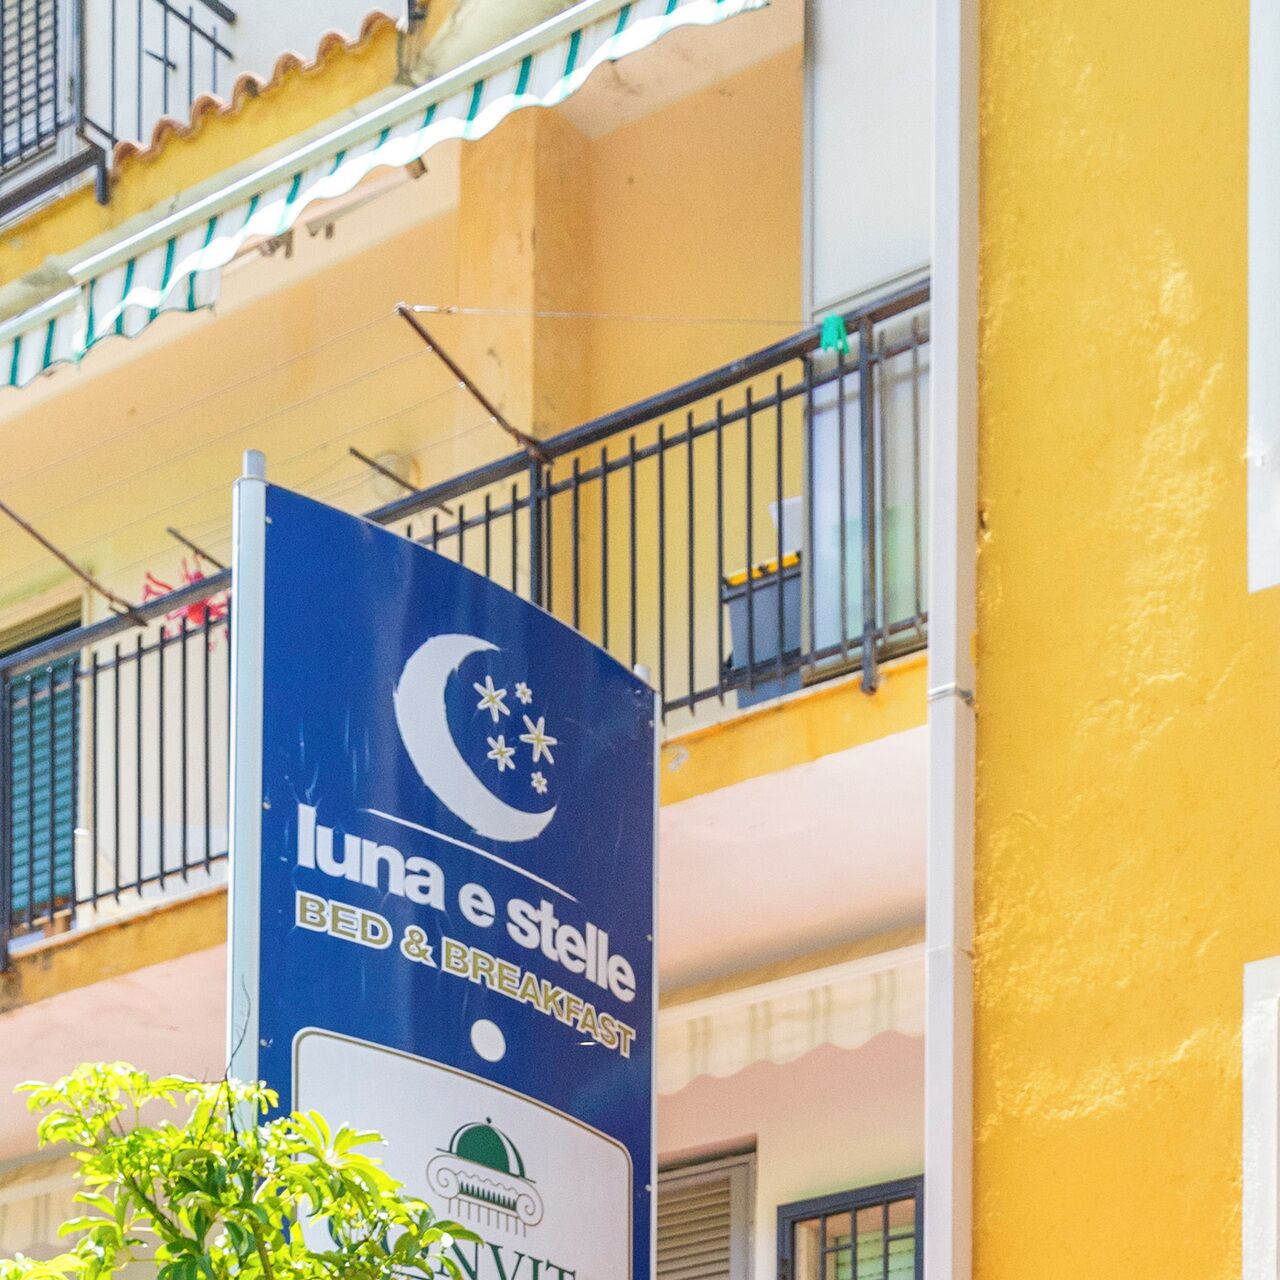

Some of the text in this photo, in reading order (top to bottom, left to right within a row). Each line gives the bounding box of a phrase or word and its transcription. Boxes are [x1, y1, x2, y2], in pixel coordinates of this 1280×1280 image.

[295, 889, 636, 1059] BED & BREAKFAST
[297, 802, 636, 1003] luna e stelle
